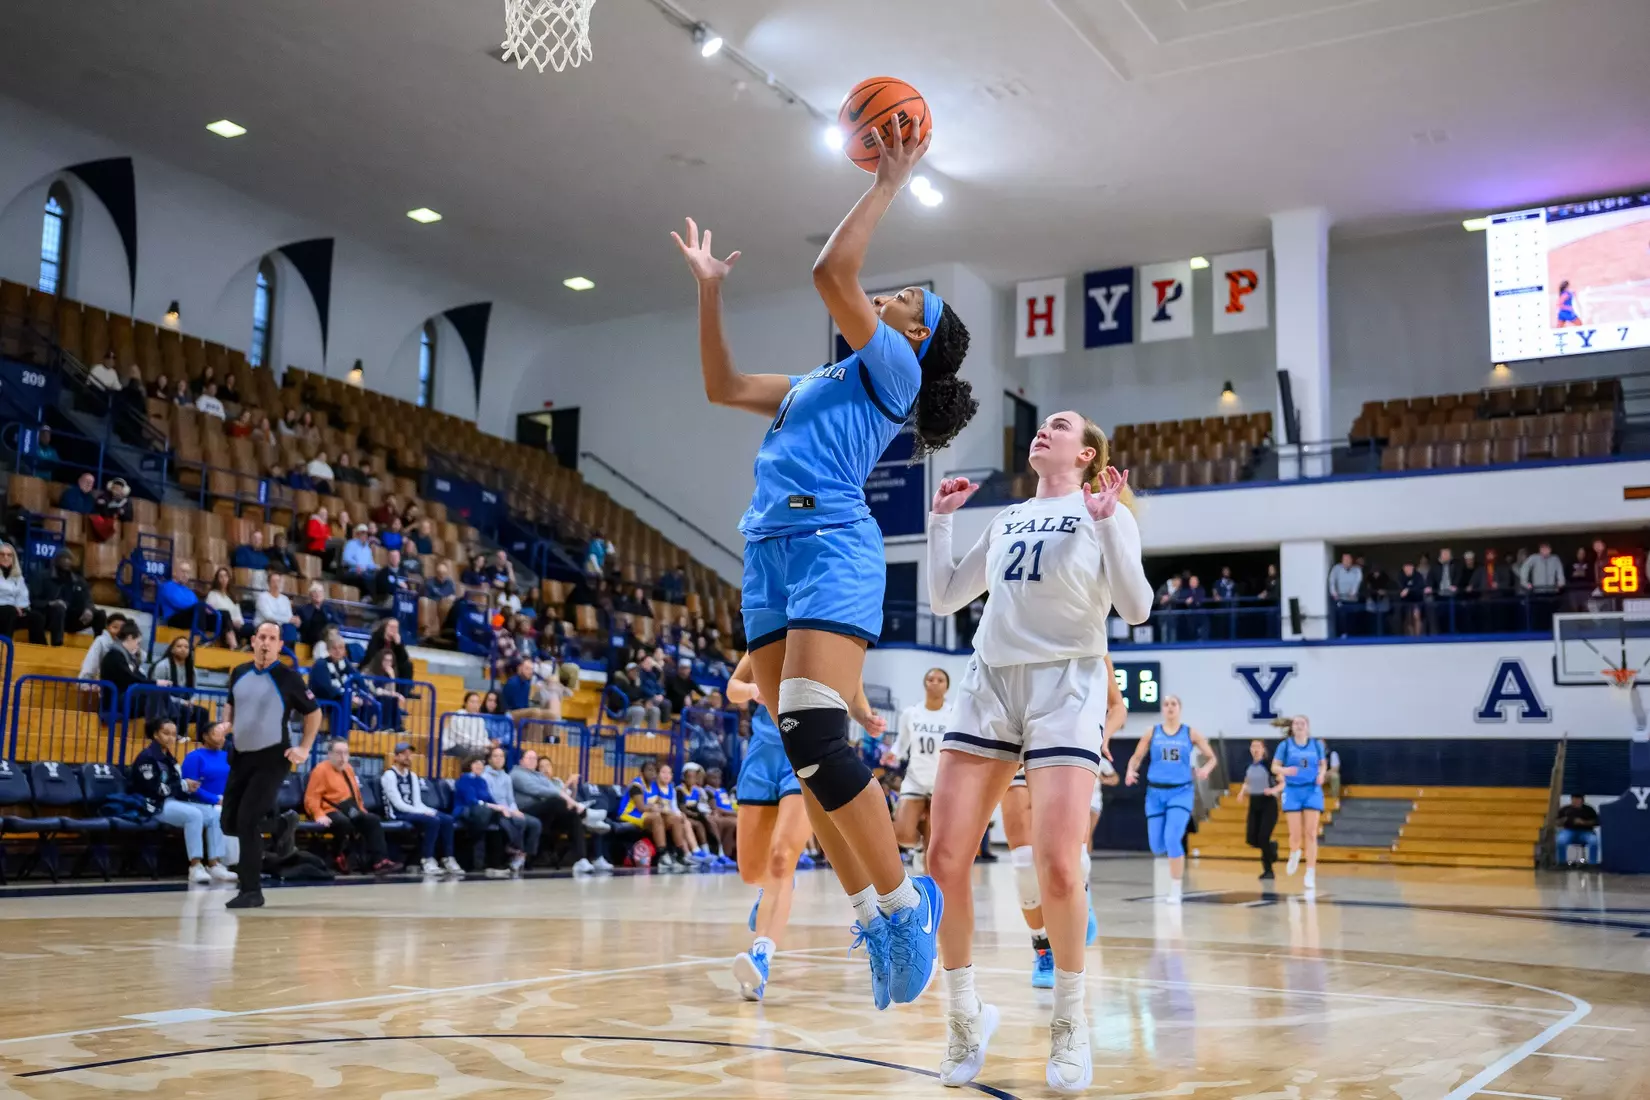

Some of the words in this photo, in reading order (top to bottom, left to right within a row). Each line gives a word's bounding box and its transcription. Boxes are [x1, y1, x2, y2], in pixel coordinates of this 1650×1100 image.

[1152, 279, 1183, 322] P
[1225, 269, 1259, 314] P
[1026, 295, 1056, 338] H
[1088, 284, 1129, 331] Y
[1576, 328, 1597, 348] Y
[1617, 327, 1629, 341] 7
[1002, 515, 1082, 536] YALE
[35, 543, 56, 557] 107
[1003, 540, 1045, 582] 21
[1603, 565, 1638, 593] 28
[1233, 662, 1297, 722] Y
[1474, 657, 1553, 723] A
[919, 736, 935, 754] 10
[1162, 747, 1180, 761] 15
[1630, 786, 1650, 810] Y
